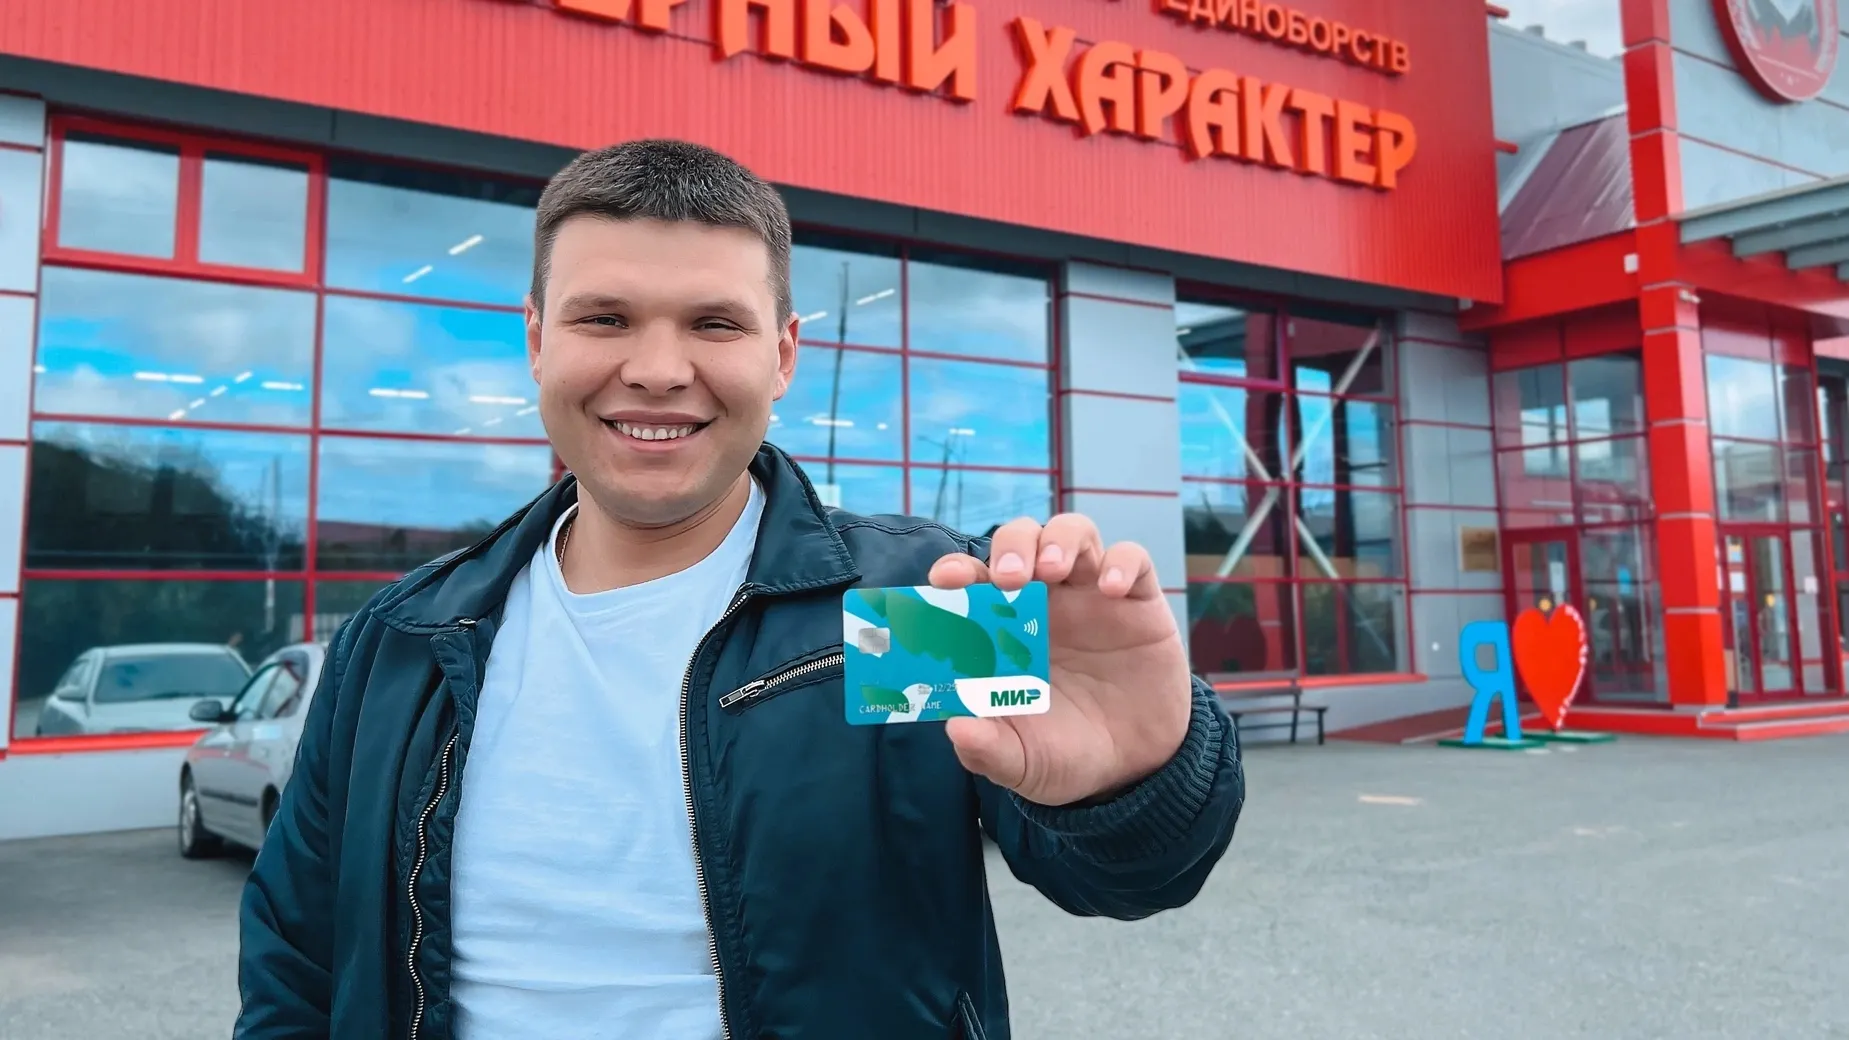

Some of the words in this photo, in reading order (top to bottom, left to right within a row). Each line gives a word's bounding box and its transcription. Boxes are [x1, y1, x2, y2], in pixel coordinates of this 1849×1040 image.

[1010, 17, 1416, 190] ХАРАКТЕР
[859, 702, 916, 714] CARDHOLDER
[990, 688, 1041, 707] МИР
[1459, 620, 1522, 744] Я
